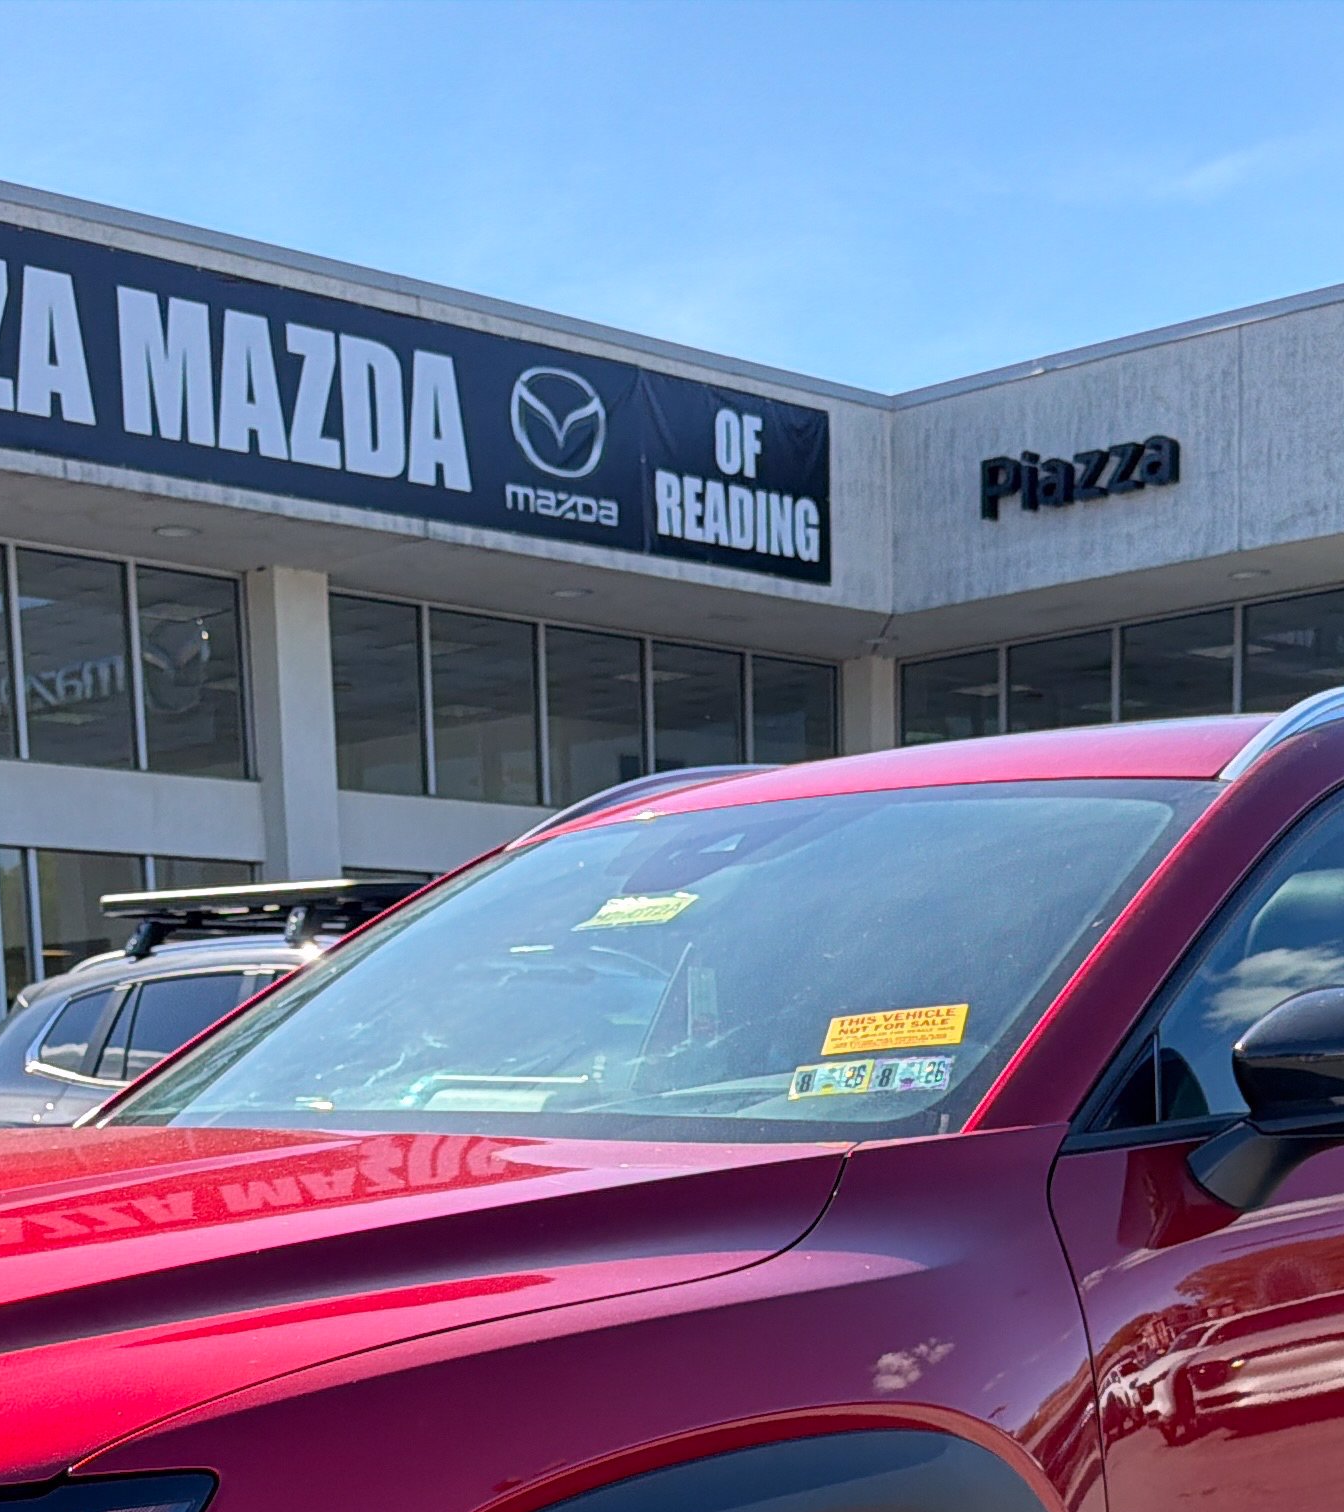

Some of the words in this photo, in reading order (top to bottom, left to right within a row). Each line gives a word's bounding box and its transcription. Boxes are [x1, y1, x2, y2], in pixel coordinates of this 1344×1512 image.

[116, 285, 472, 492] MAZDA
[714, 408, 763, 478] OF
[981, 435, 1180, 521] Piazza
[506, 482, 619, 527] mazda
[656, 470, 820, 563] READING
[838, 1017, 877, 1028] THIS
[882, 1008, 957, 1023] VEHICLE
[838, 1025, 867, 1036] NOT
[873, 1022, 906, 1032] FOR
[910, 1018, 950, 1028] SALE
